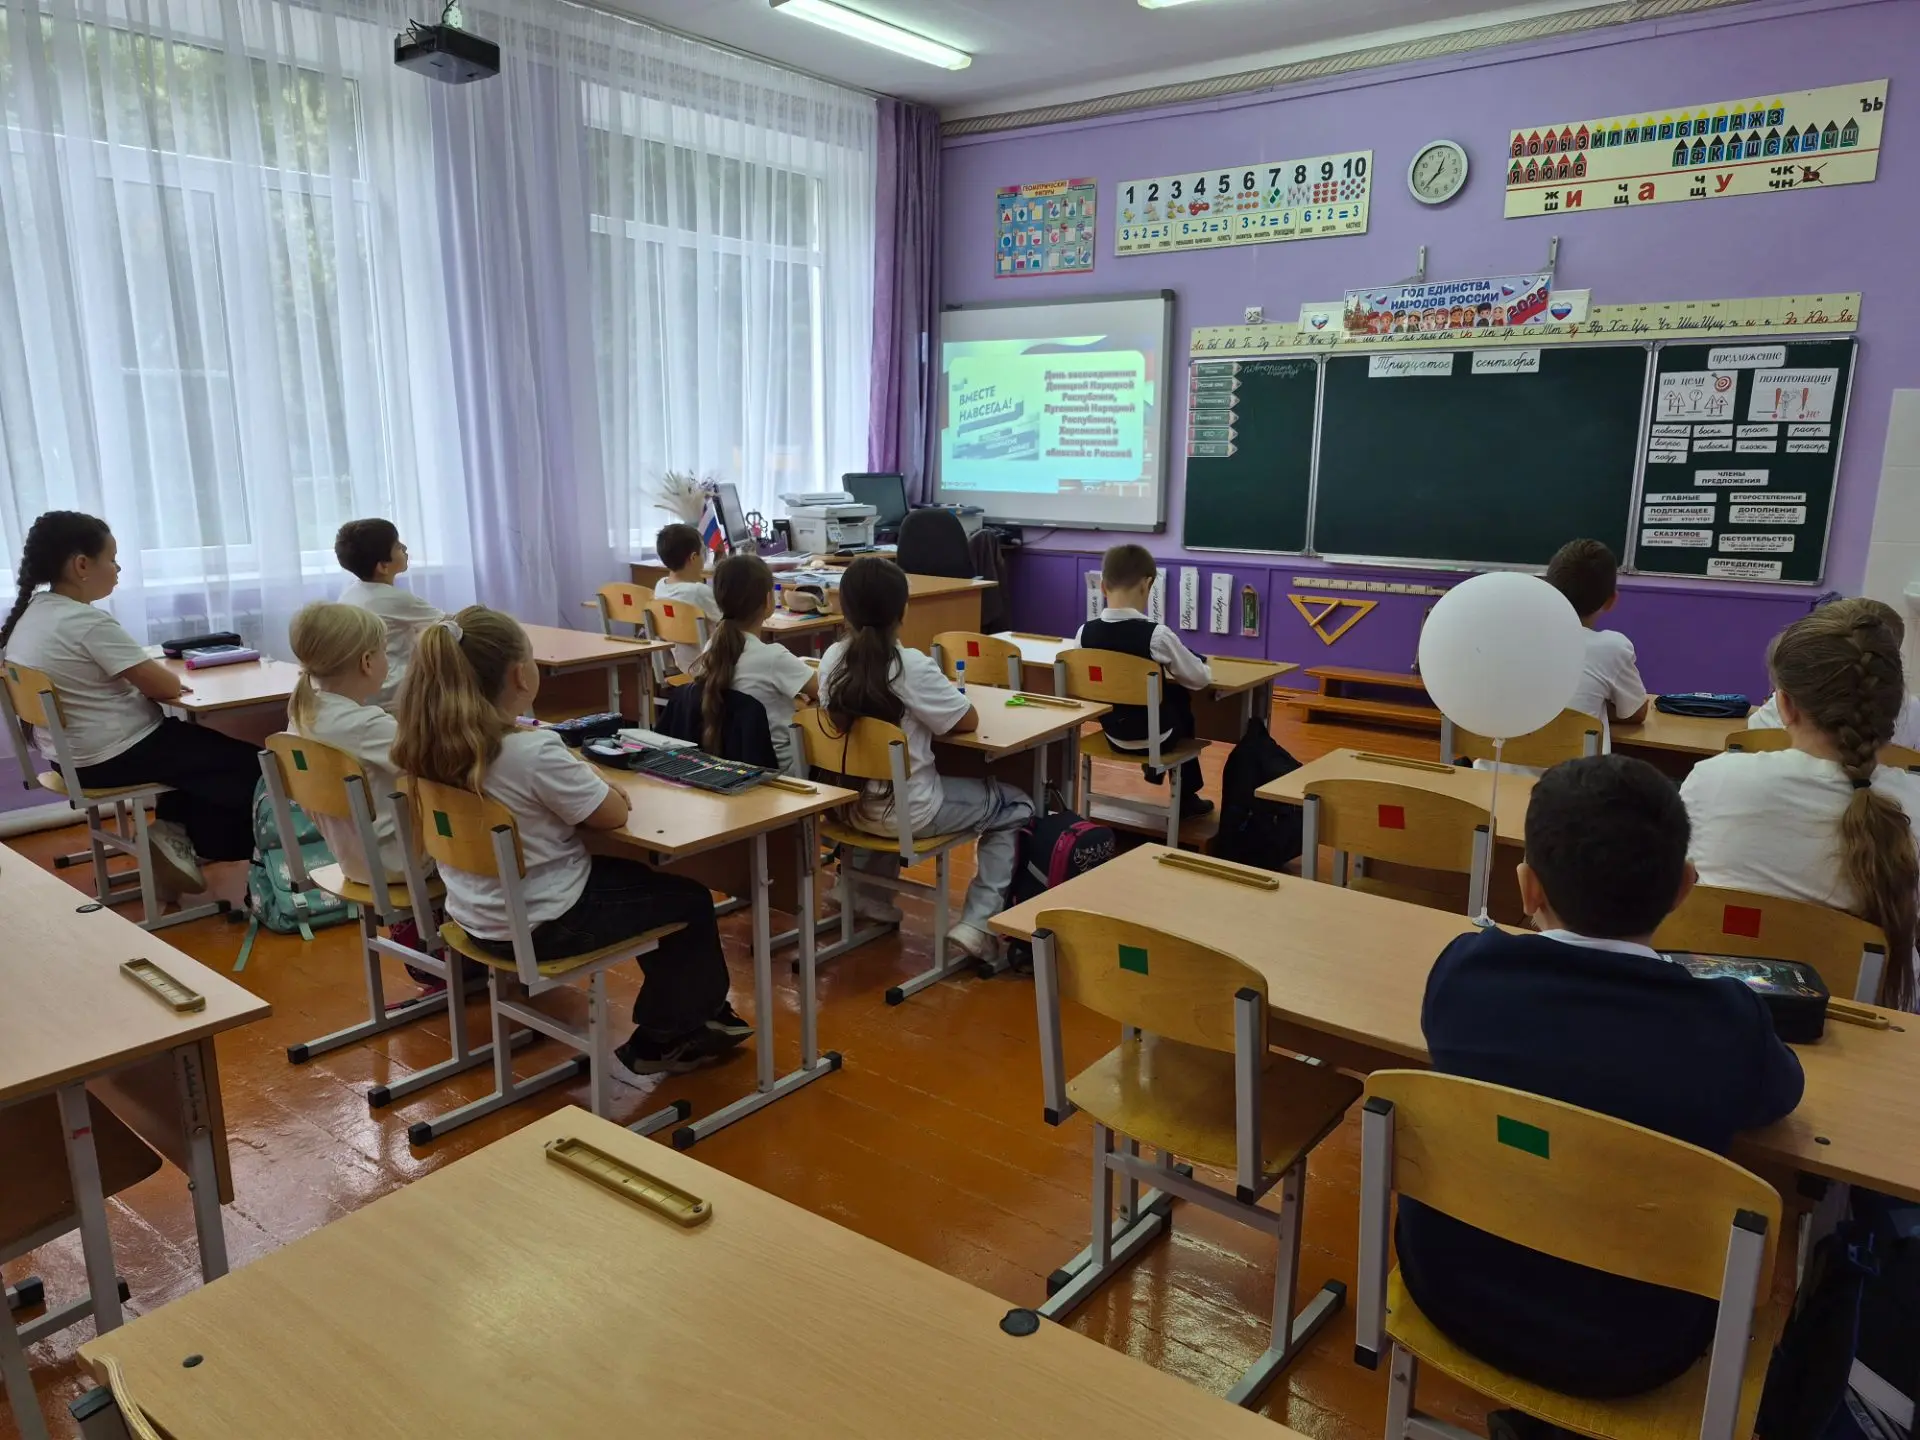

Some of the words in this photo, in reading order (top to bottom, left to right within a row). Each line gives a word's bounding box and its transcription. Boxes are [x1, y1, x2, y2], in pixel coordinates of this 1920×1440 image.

[1514, 144, 1523, 157] а
[1530, 142, 1538, 153] о
[1546, 141, 1553, 153] у
[1560, 139, 1571, 151] ы
[1578, 137, 1587, 149] э
[1594, 129, 1603, 147] й
[1626, 131, 1637, 143] м
[1644, 130, 1654, 140] н
[1662, 124, 1671, 139] р
[1679, 122, 1690, 136] б
[1697, 120, 1706, 134] в
[1750, 113, 1764, 127] ж
[1770, 110, 1781, 125] з
[1747, 142, 1760, 155] ш
[1767, 140, 1777, 154] с
[1512, 172, 1521, 184] я
[1542, 168, 1553, 179] ю
[1559, 166, 1568, 178] и
[1576, 164, 1584, 176] е
[1771, 165, 1795, 176] чк
[1126, 186, 1135, 204] 1
[1148, 184, 1159, 202] 2
[1171, 181, 1182, 199] 3
[1194, 177, 1206, 195] 4
[1218, 175, 1230, 194] 5
[1243, 171, 1255, 190] 6
[1269, 168, 1281, 187] 7
[1294, 165, 1307, 184] 8
[1321, 161, 1334, 181] 9
[1344, 157, 1366, 178] 10
[1695, 175, 1705, 183] ч
[1769, 179, 1794, 189] чн
[1545, 191, 1559, 200] ж
[1618, 184, 1628, 192] ч
[1638, 182, 1655, 201] а
[1690, 187, 1706, 197] щ
[1544, 202, 1558, 211] ш
[1566, 190, 1583, 208] и
[1614, 195, 1629, 205] щ
[1242, 217, 1248, 228] 3
[1261, 216, 1266, 226] 2
[1284, 213, 1289, 224] 6
[1304, 211, 1311, 222] 6
[1328, 208, 1334, 219] 2
[1353, 206, 1359, 217] 3
[1123, 230, 1129, 241] 3
[1142, 228, 1147, 238] 2
[1163, 226, 1168, 236] 5
[1183, 224, 1189, 235] 5
[1202, 222, 1207, 232] 2
[1223, 220, 1228, 230] 3
[1402, 286, 1425, 298] ГОД
[1428, 281, 1491, 295] ЕДИНСТВА
[1391, 298, 1445, 310] НАРОДОВ
[1450, 293, 1499, 304] РОССИИ
[1507, 287, 1550, 319] 2026
[1476, 352, 1537, 371] сентября
[1712, 351, 1782, 365] предложение
[960, 385, 996, 406] ВМЕСТЕ
[960, 398, 1012, 422] НАВСЕГДА!
[1714, 560, 1775, 569] ОПРЕДЕЛЕНИЕ
